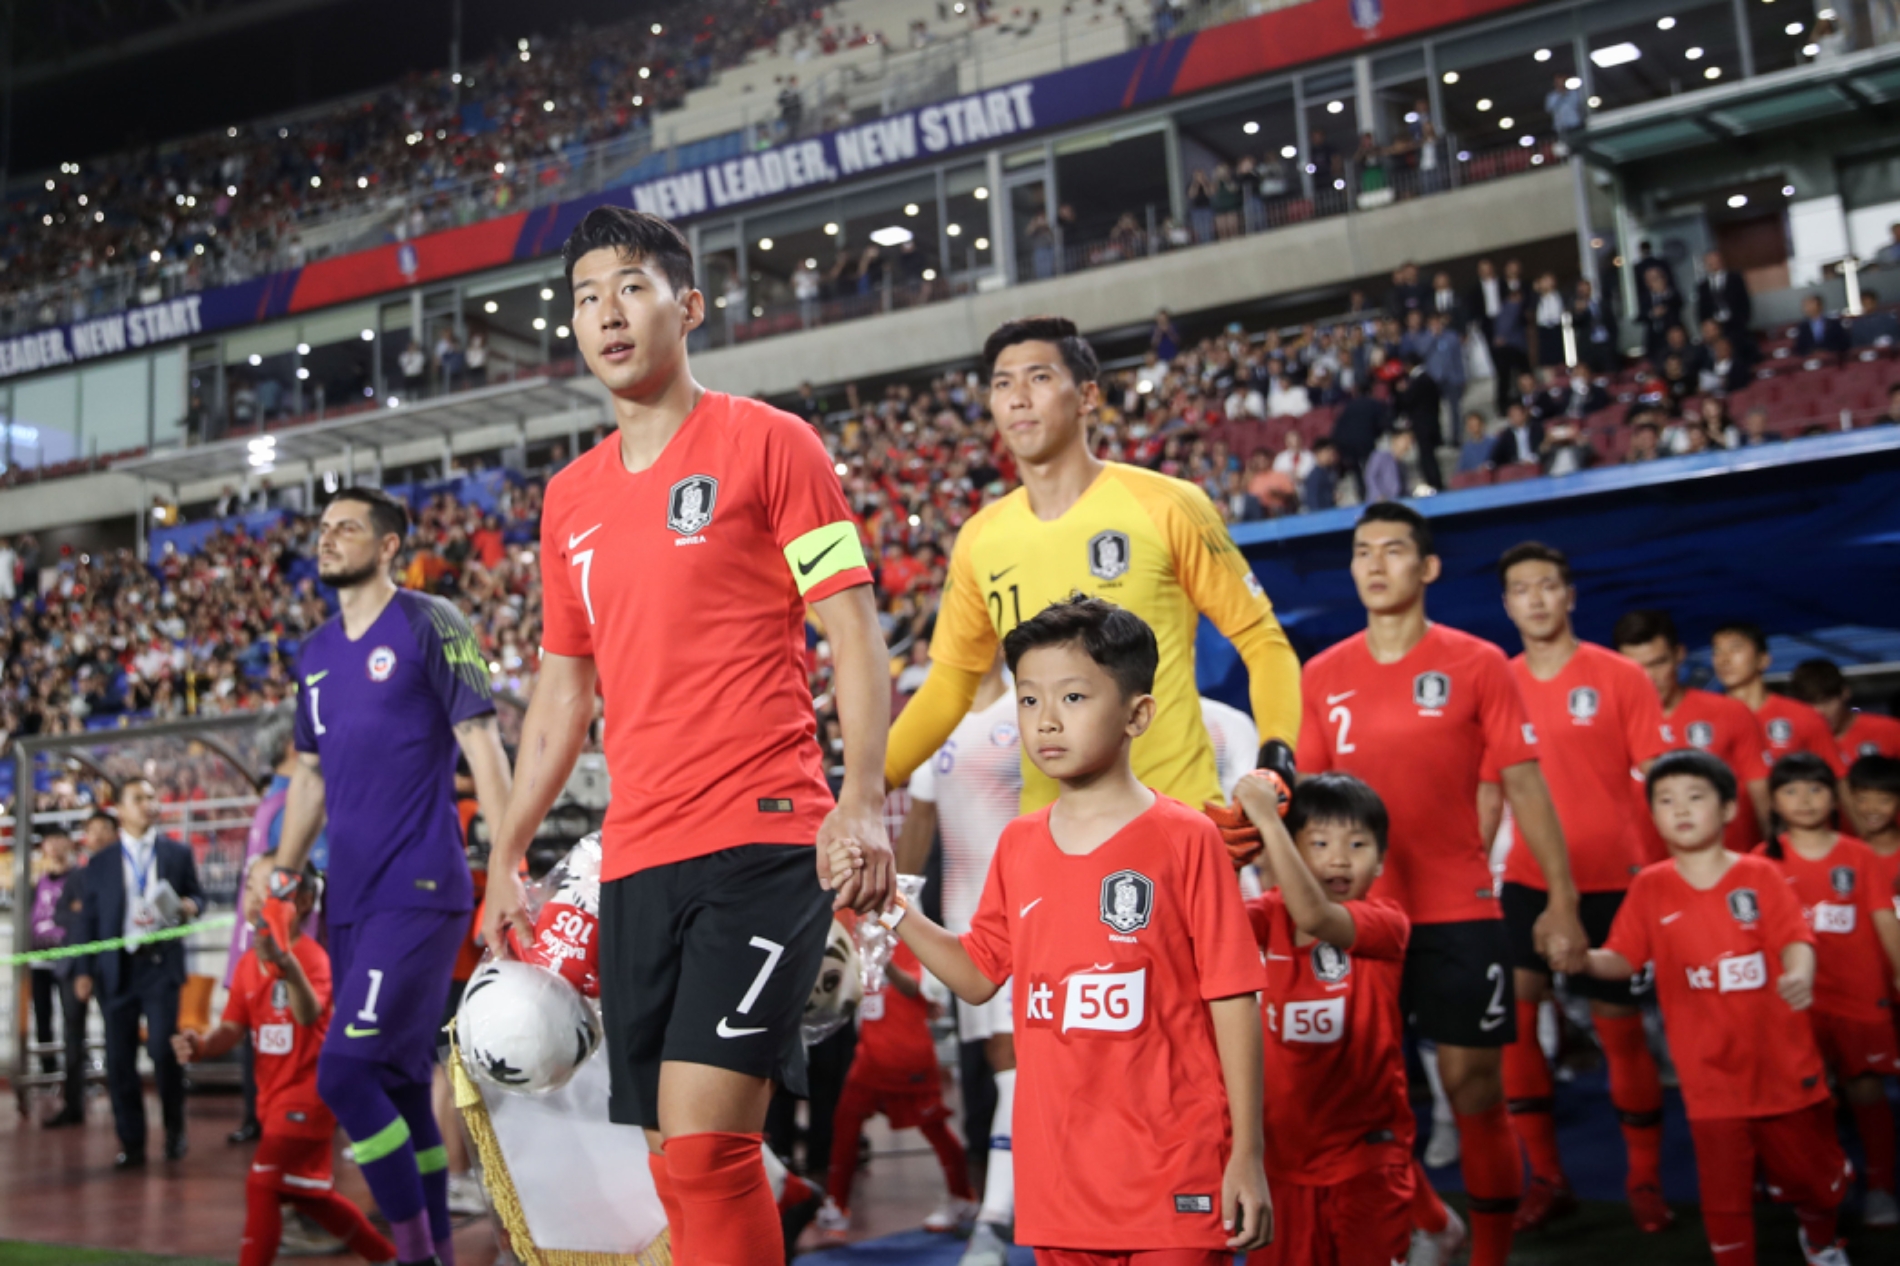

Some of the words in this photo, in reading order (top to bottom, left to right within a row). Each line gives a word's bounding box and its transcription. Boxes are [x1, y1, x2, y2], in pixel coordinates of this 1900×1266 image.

[632, 171, 707, 220] NEW
[708, 139, 837, 205] LEADER,
[834, 113, 917, 174] NEW
[919, 83, 1035, 152] START
[71, 315, 126, 358] NEW
[129, 297, 201, 346] START
[572, 548, 595, 625] 7
[988, 585, 1021, 634] 21
[310, 687, 326, 735] 1
[1328, 705, 1355, 754] 2
[551, 910, 594, 945] 105
[357, 968, 384, 1023] 1
[736, 935, 785, 1014] 7
[1486, 962, 1506, 1015] 2
[1727, 960, 1758, 984] 5G
[1026, 982, 1054, 1019] kt
[1079, 983, 1130, 1020] 5G
[1294, 1007, 1333, 1036] 5G
